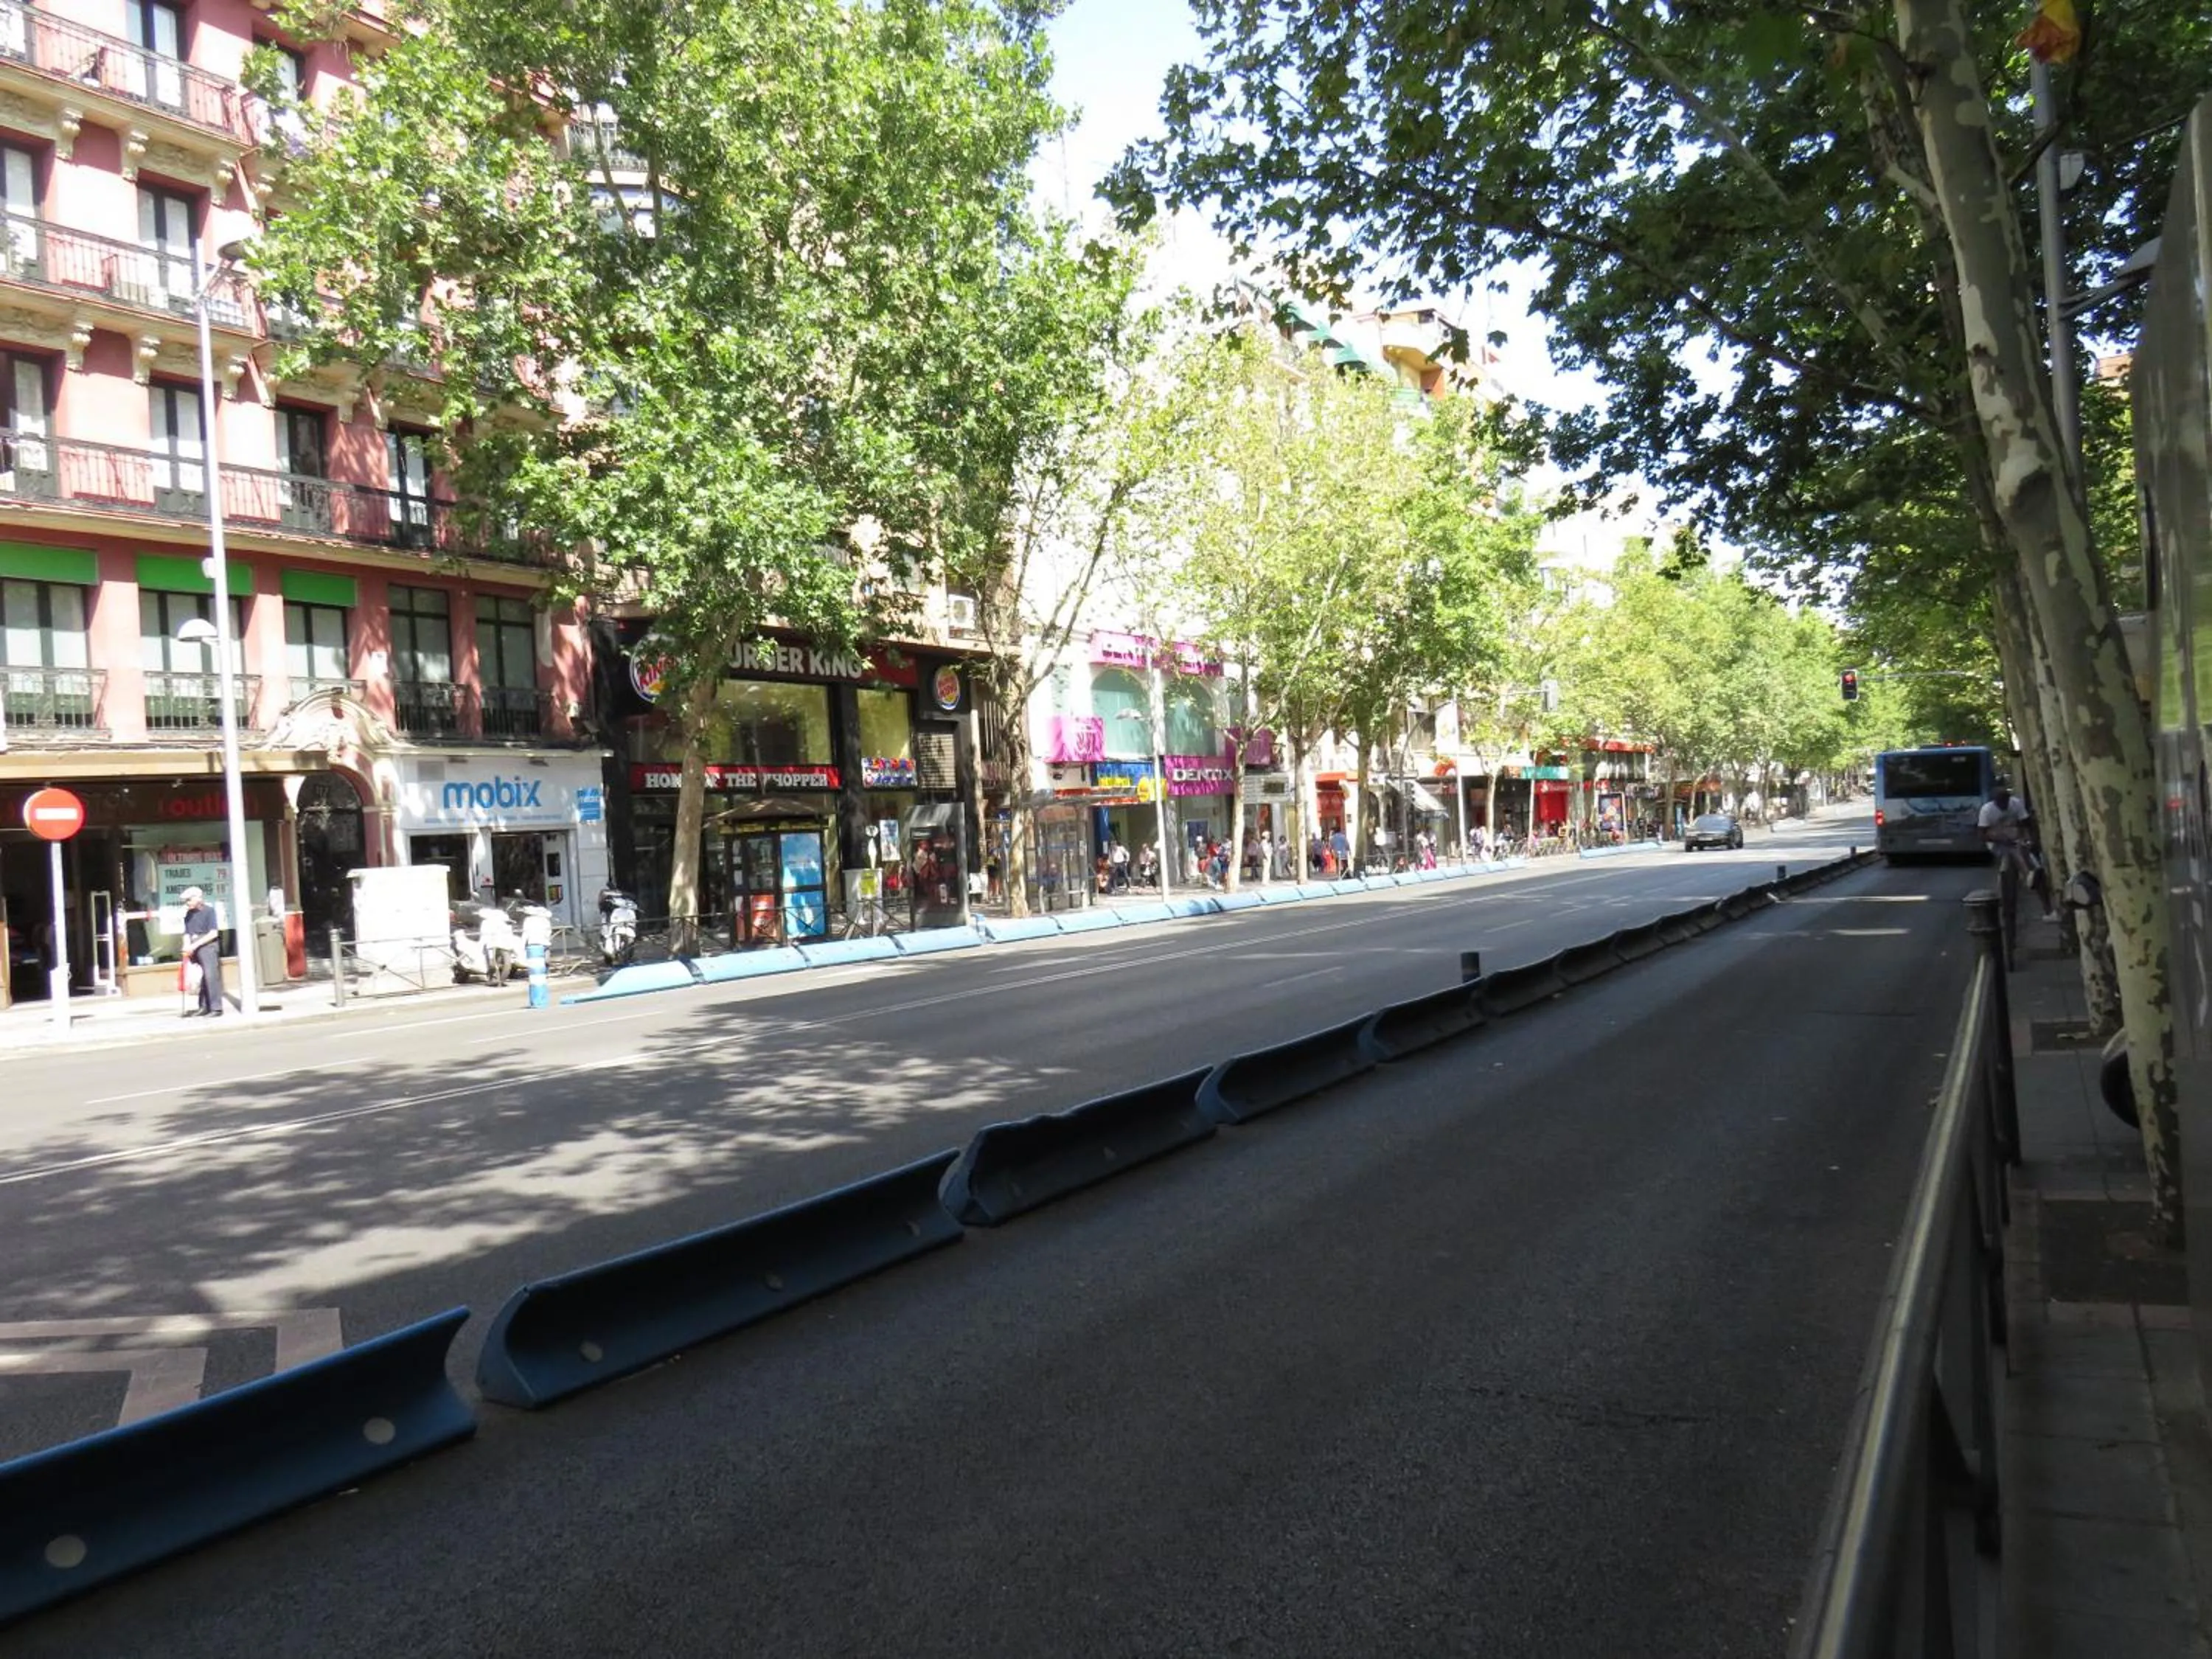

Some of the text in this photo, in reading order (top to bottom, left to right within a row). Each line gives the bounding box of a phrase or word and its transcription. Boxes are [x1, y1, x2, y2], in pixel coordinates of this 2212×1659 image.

[727, 640, 863, 679] URER KING
[645, 773, 682, 788] HOM
[726, 773, 757, 788] THE
[1172, 768, 1234, 782] DENTIX
[443, 776, 543, 810] mobix
